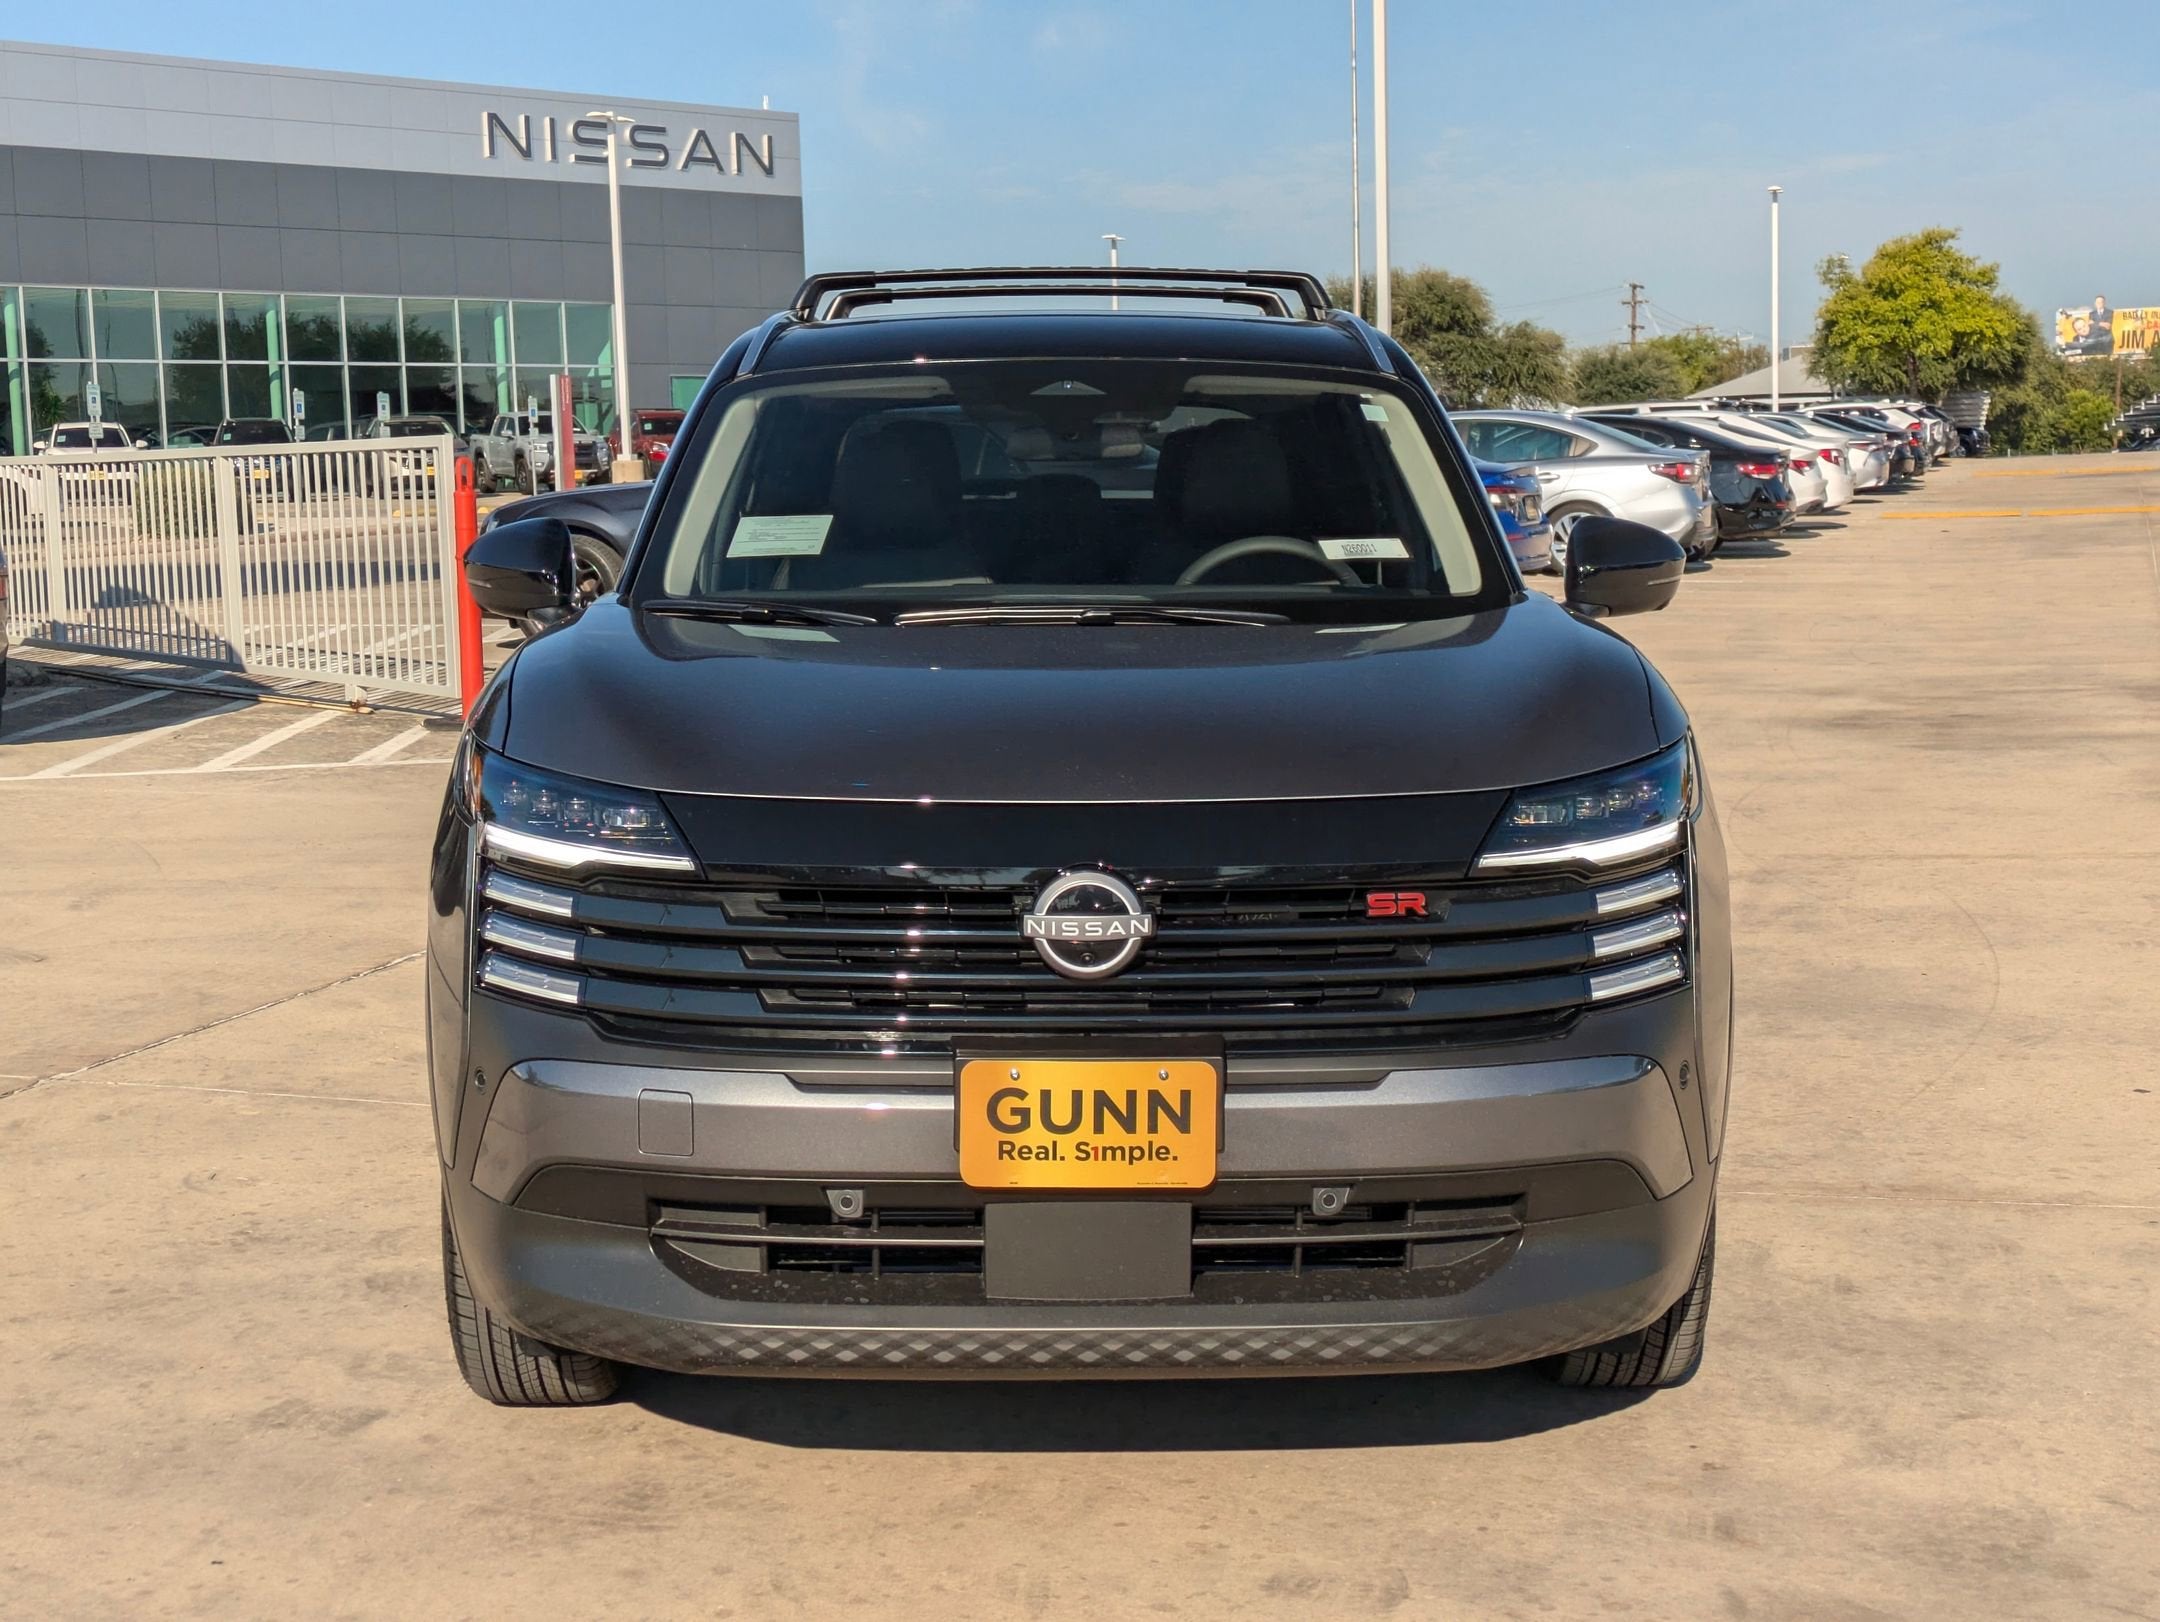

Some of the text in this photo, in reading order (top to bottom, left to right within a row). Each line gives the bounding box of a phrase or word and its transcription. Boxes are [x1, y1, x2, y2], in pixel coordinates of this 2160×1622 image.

[481, 111, 775, 177] NISSAN
[2119, 330, 2145, 349] JIM
[1366, 892, 1429, 917] SR
[1027, 918, 1150, 936] NISSAN
[986, 1087, 1192, 1135] GUNN
[997, 1140, 1066, 1162] Real.
